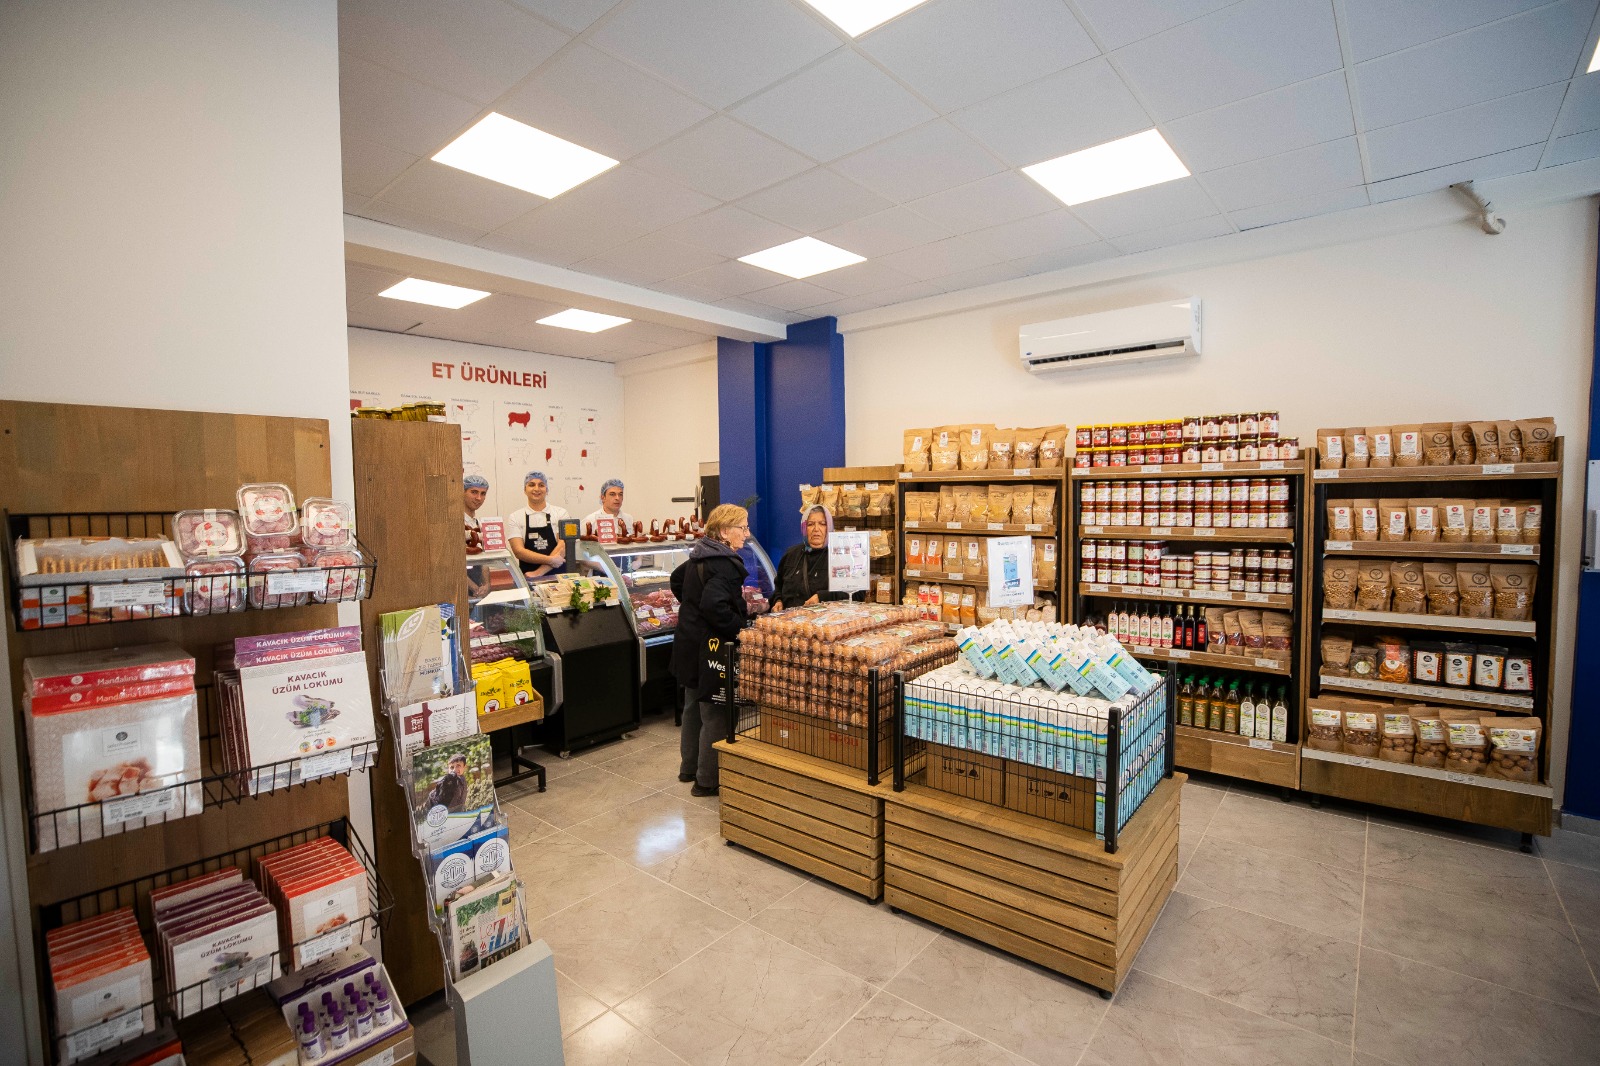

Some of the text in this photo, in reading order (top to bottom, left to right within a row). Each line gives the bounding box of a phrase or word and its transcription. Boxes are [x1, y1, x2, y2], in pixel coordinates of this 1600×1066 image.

[432, 362, 548, 388] ET ÜRÜNLERİ
[256, 632, 345, 648] KAVACIK ÜZÜM LOKUMU
[256, 646, 345, 664] KAVACIK ÜZÜM LOKUMU
[97, 675, 138, 686] Mandalina
[287, 671, 327, 683] KAVACIK
[272, 677, 343, 695] ÜZÜM LOKUMU
